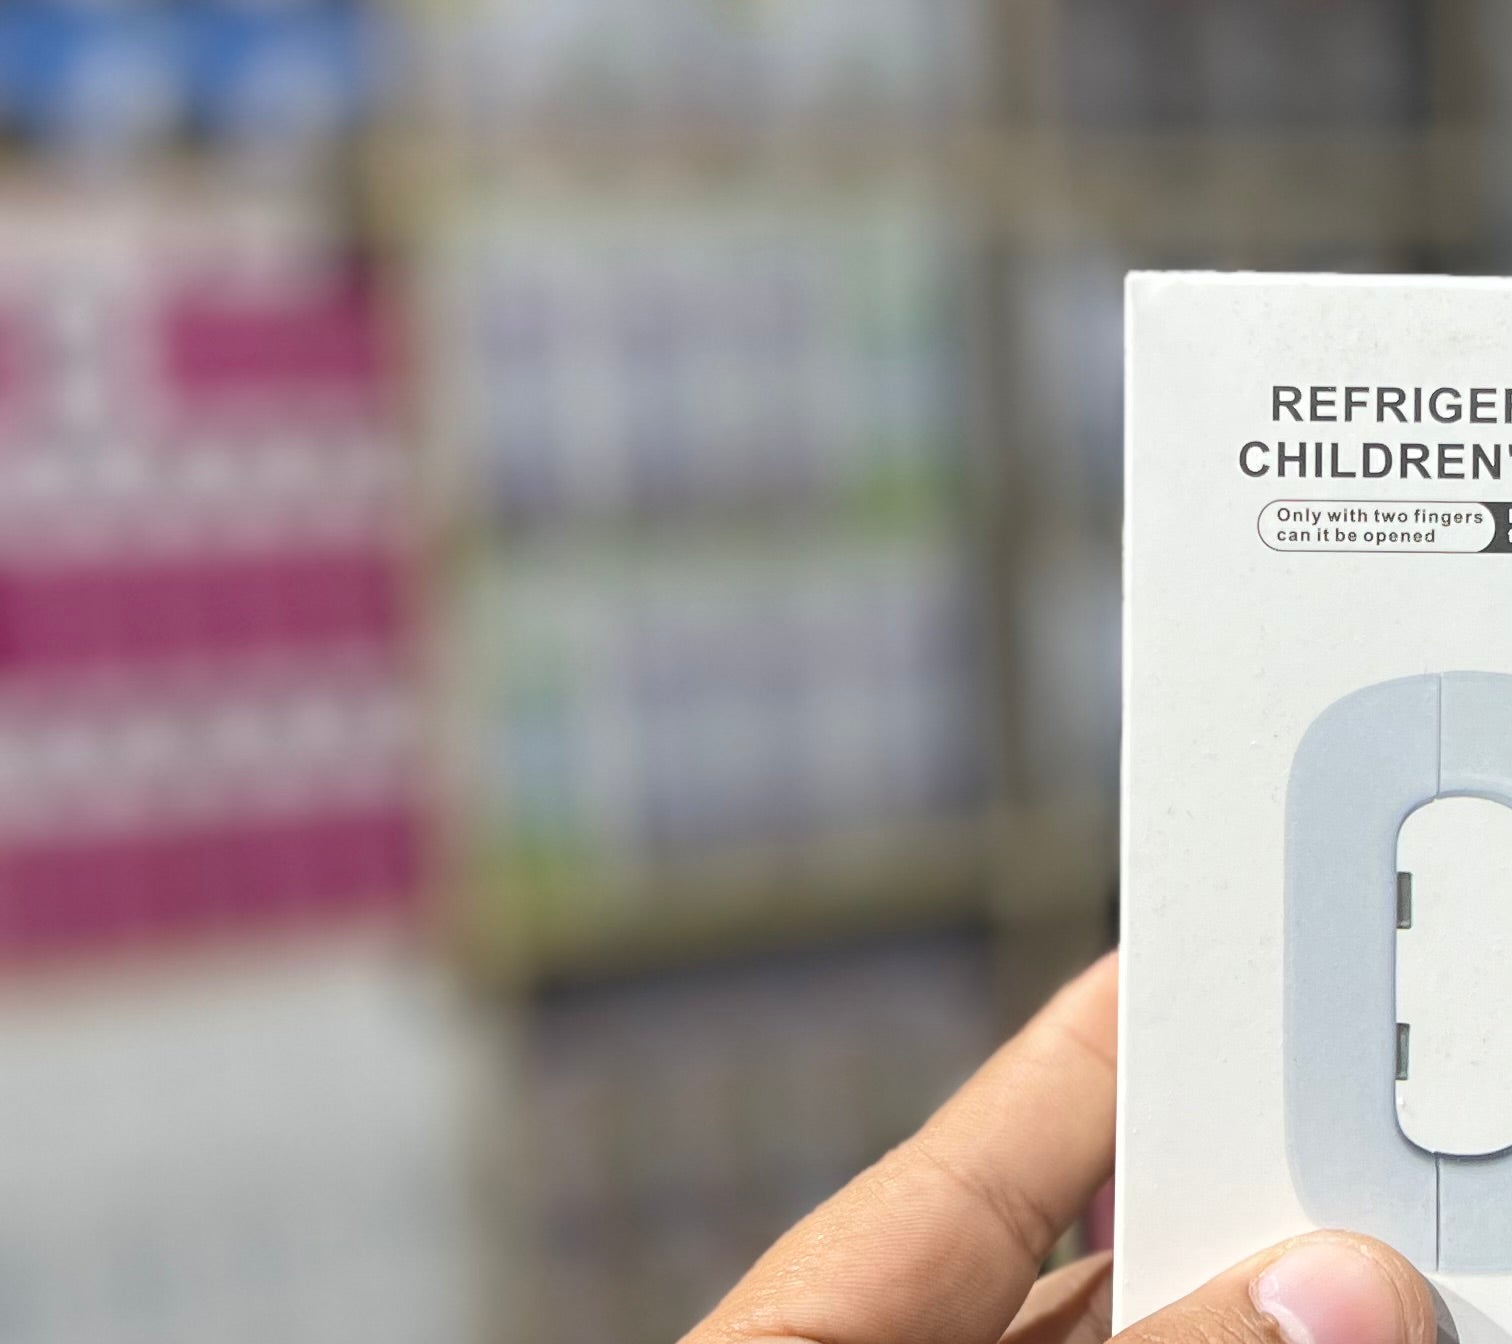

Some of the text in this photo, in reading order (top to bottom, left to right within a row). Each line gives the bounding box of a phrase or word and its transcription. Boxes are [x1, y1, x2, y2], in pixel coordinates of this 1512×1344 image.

[1277, 507, 1483, 527] Only with two fingers
[1277, 528, 1435, 546] can it be opened
